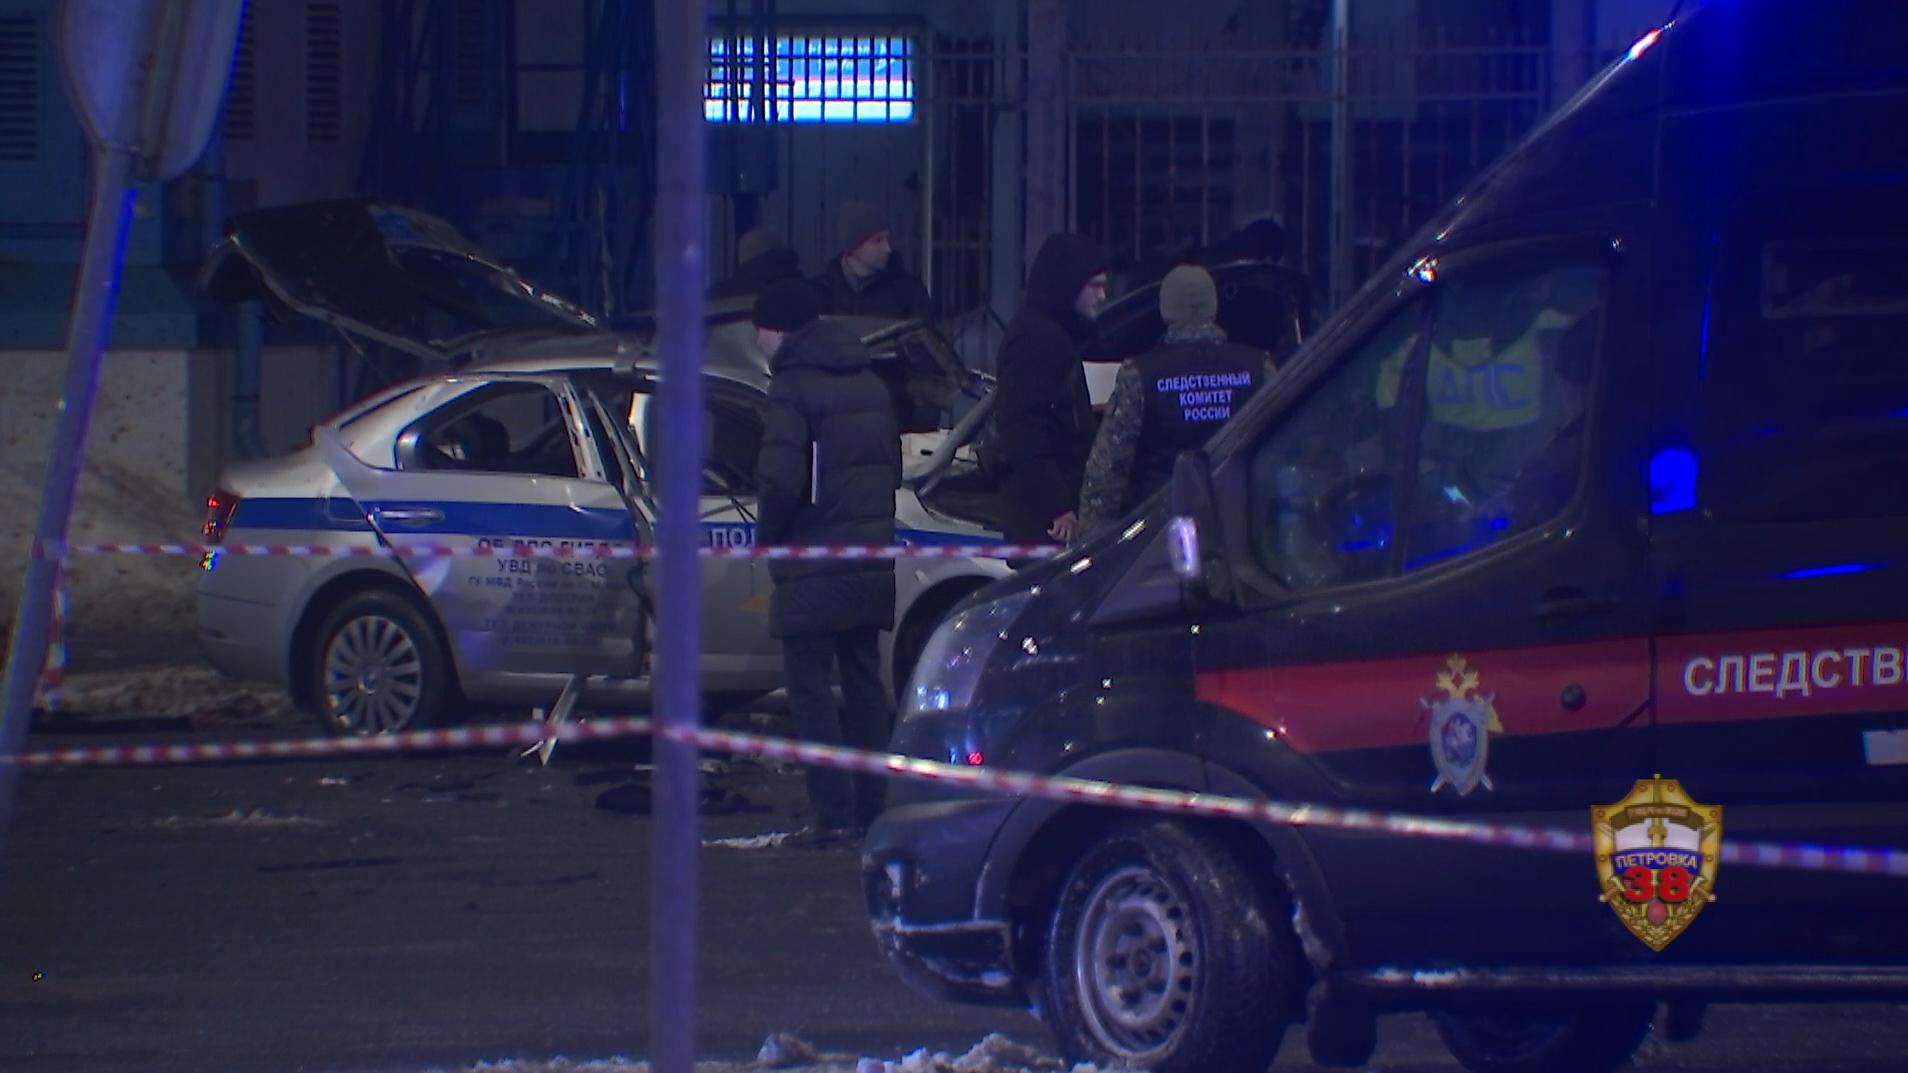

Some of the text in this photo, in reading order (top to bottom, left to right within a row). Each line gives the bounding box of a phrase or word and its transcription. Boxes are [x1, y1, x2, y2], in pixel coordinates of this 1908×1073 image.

[1156, 370, 1251, 392] СЛЕДСТВЕННЫЙ
[1179, 389, 1233, 406] КОМИТЕТ
[1184, 406, 1230, 421] РОССИИ
[496, 558, 531, 574] УВД
[561, 562, 609, 577] СВАО
[1685, 646, 1908, 700] СЛЕДСТВ
